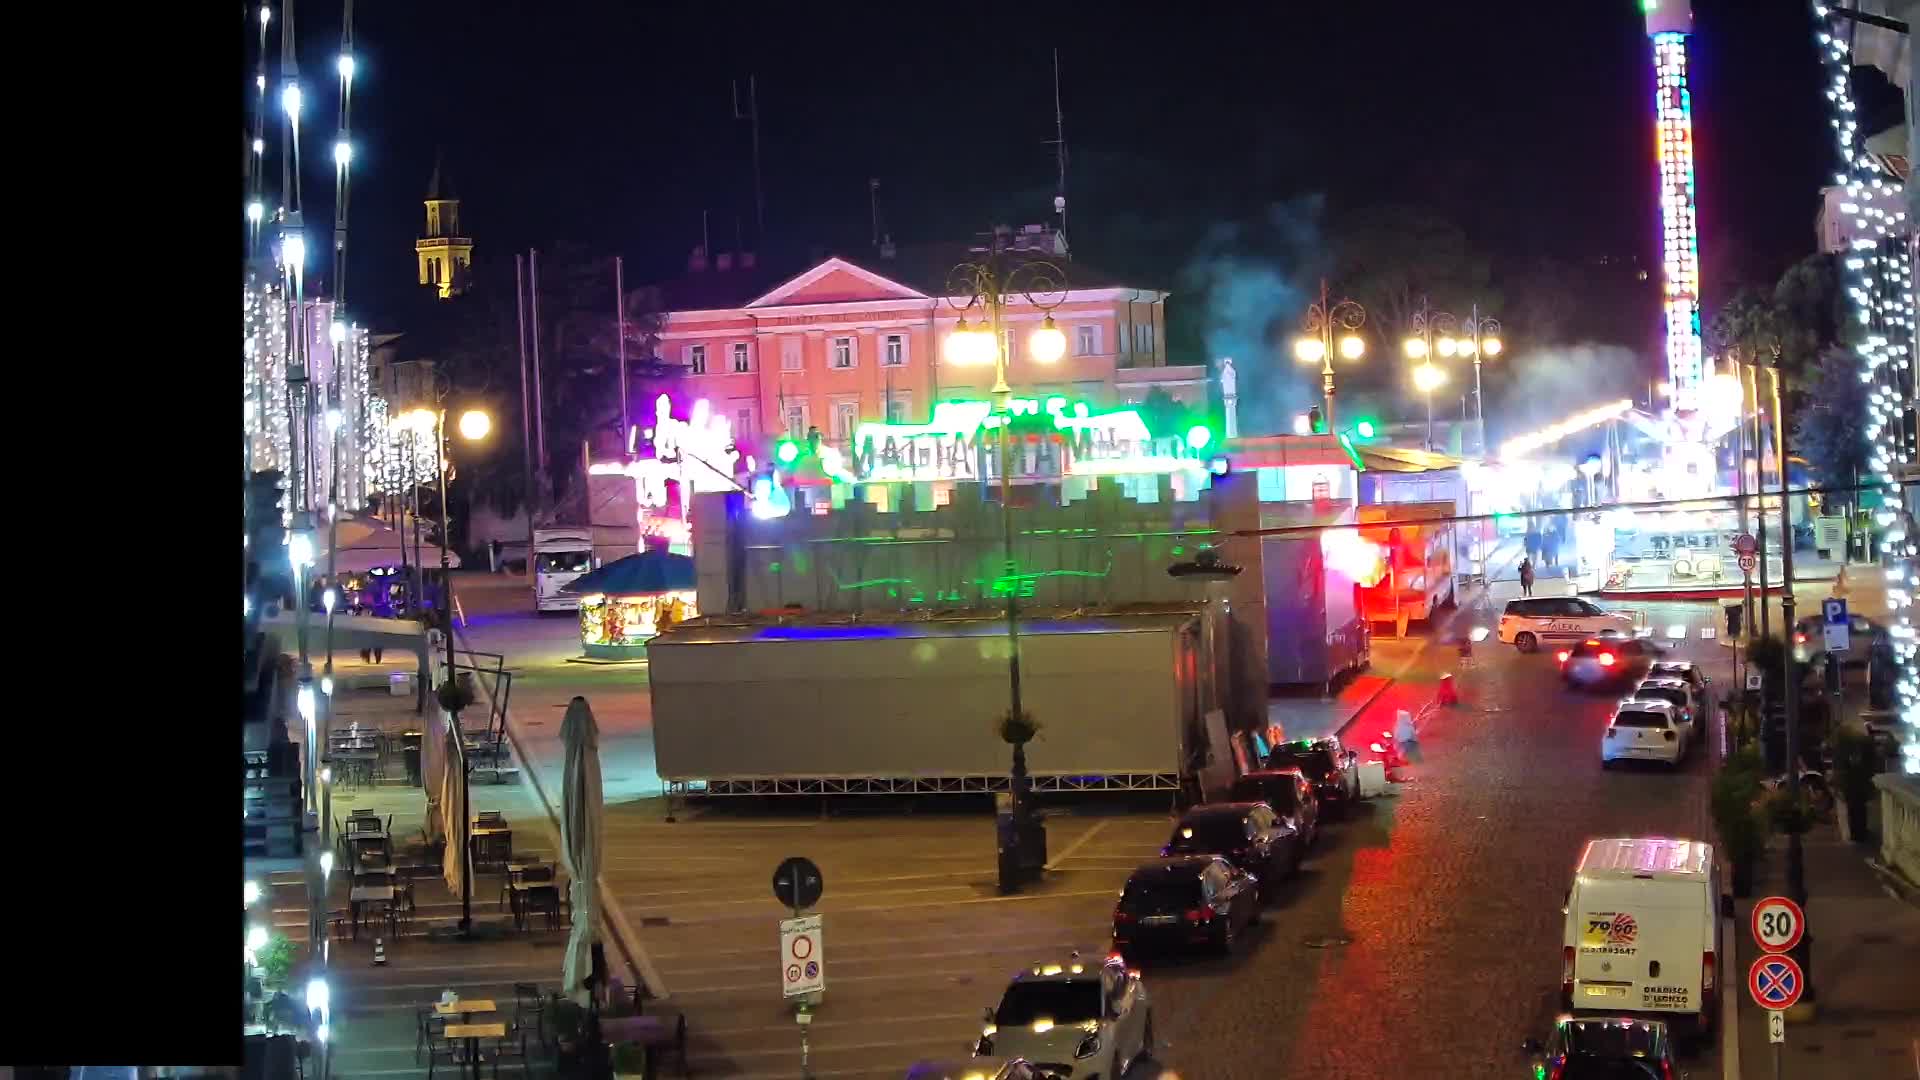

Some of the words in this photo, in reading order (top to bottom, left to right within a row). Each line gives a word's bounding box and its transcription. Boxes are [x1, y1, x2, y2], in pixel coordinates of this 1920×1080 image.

[1742, 558, 1753, 567] 20
[1826, 602, 1841, 622] P
[1762, 911, 1791, 938] 30
